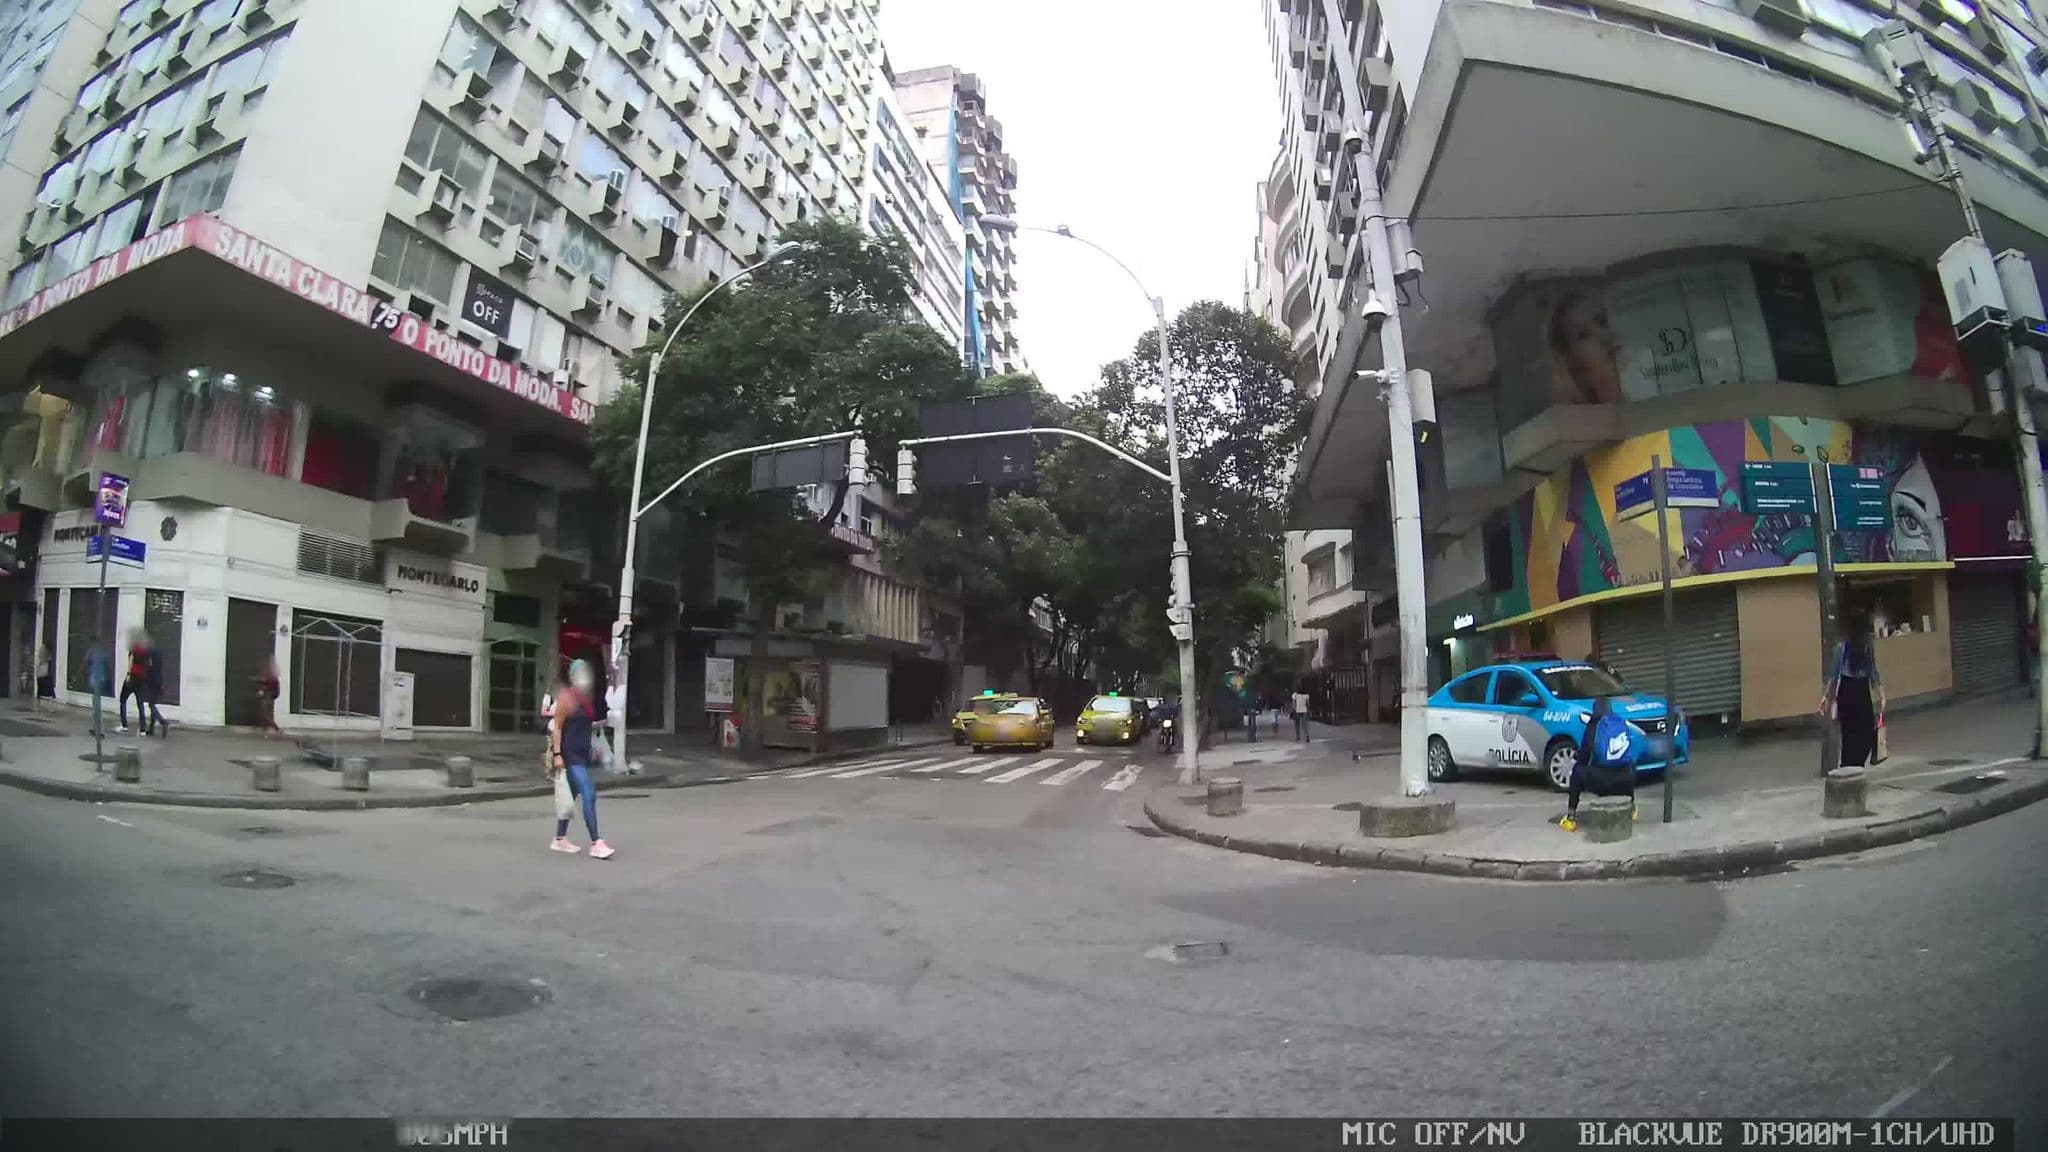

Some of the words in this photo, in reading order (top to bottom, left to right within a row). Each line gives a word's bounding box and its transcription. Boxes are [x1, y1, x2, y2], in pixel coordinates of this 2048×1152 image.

[94, 252, 119, 287] DA
[126, 222, 185, 271] MODA
[215, 227, 292, 287] SANTA
[298, 265, 369, 326] CLARA
[403, 317, 419, 345] O
[425, 327, 484, 380] PONTO
[489, 359, 511, 390] DA
[473, 300, 500, 324] OFF
[397, 564, 479, 593] MONTECARLO
